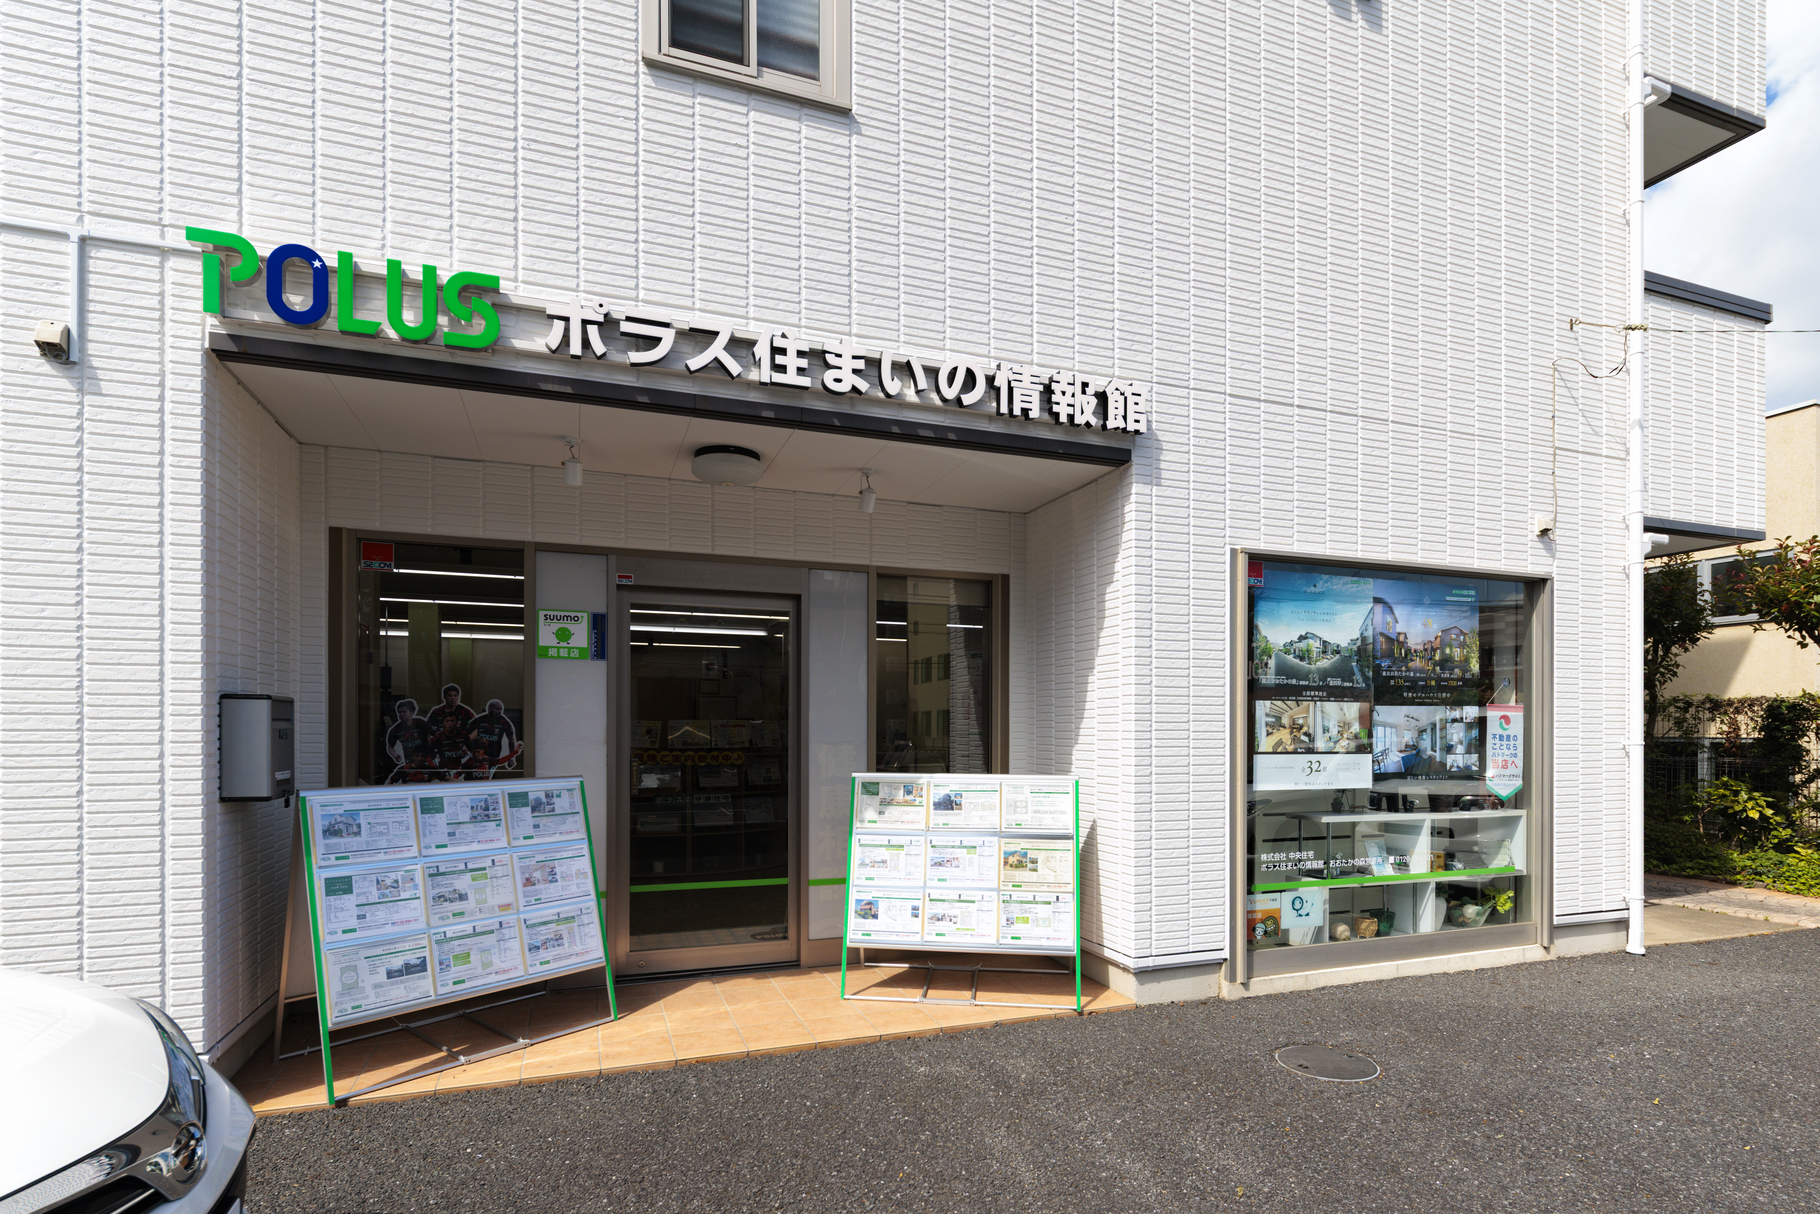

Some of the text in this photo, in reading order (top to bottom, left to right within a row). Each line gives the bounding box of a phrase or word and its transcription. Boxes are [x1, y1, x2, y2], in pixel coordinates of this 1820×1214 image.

[185, 226, 500, 349] POLUS
[545, 297, 1150, 434] ポラス住まいの情報館
[363, 561, 392, 569] SECOM
[548, 648, 579, 657] 掲載店
[1491, 733, 1518, 742] 不動産の
[1491, 742, 1518, 751] ことなら
[1491, 758, 1518, 769] 当店へ
[1260, 850, 1315, 861] 株式会社 中央住宅
[1260, 860, 1324, 871] ポラス住まいの情報館
